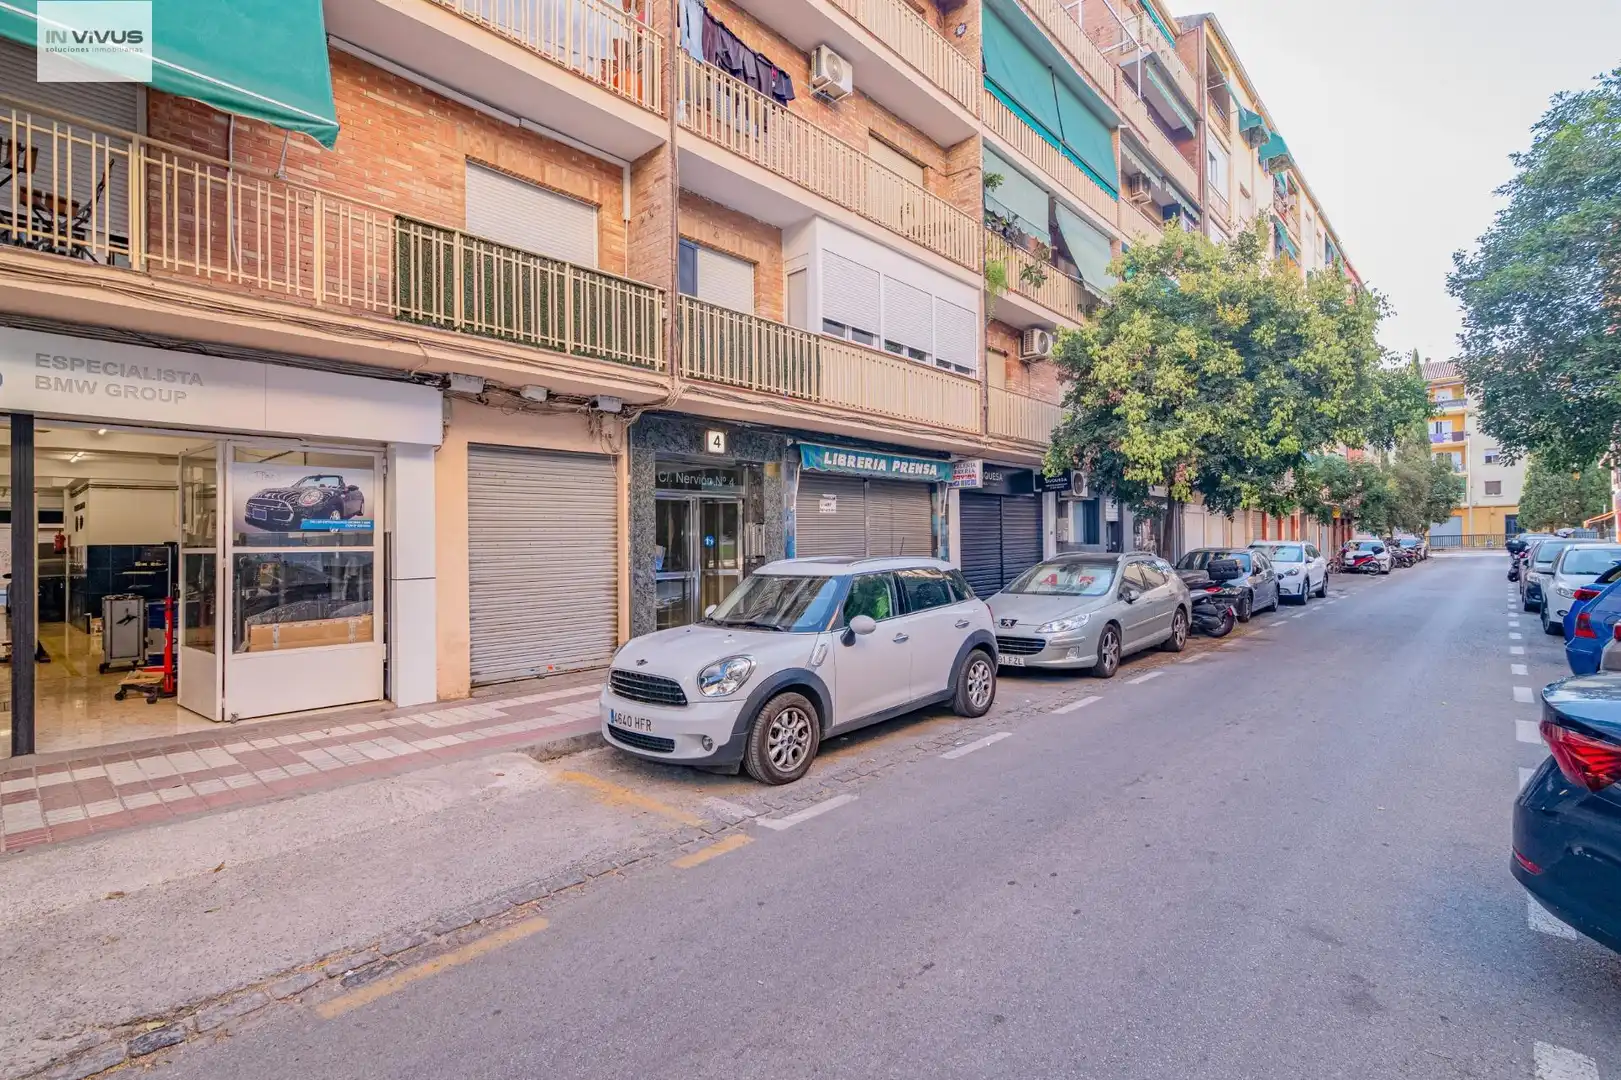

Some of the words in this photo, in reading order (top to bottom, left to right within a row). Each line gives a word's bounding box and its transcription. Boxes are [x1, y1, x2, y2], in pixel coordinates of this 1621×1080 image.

[34, 352, 204, 386] ESPECIALISTA
[34, 375, 98, 396] BMW
[104, 383, 188, 405] GROUP
[713, 434, 722, 449] 4
[823, 451, 887, 472] LIBRERIA
[892, 459, 938, 476] PRENSA
[614, 712, 633, 728] 4640
[634, 716, 652, 732] HFR
